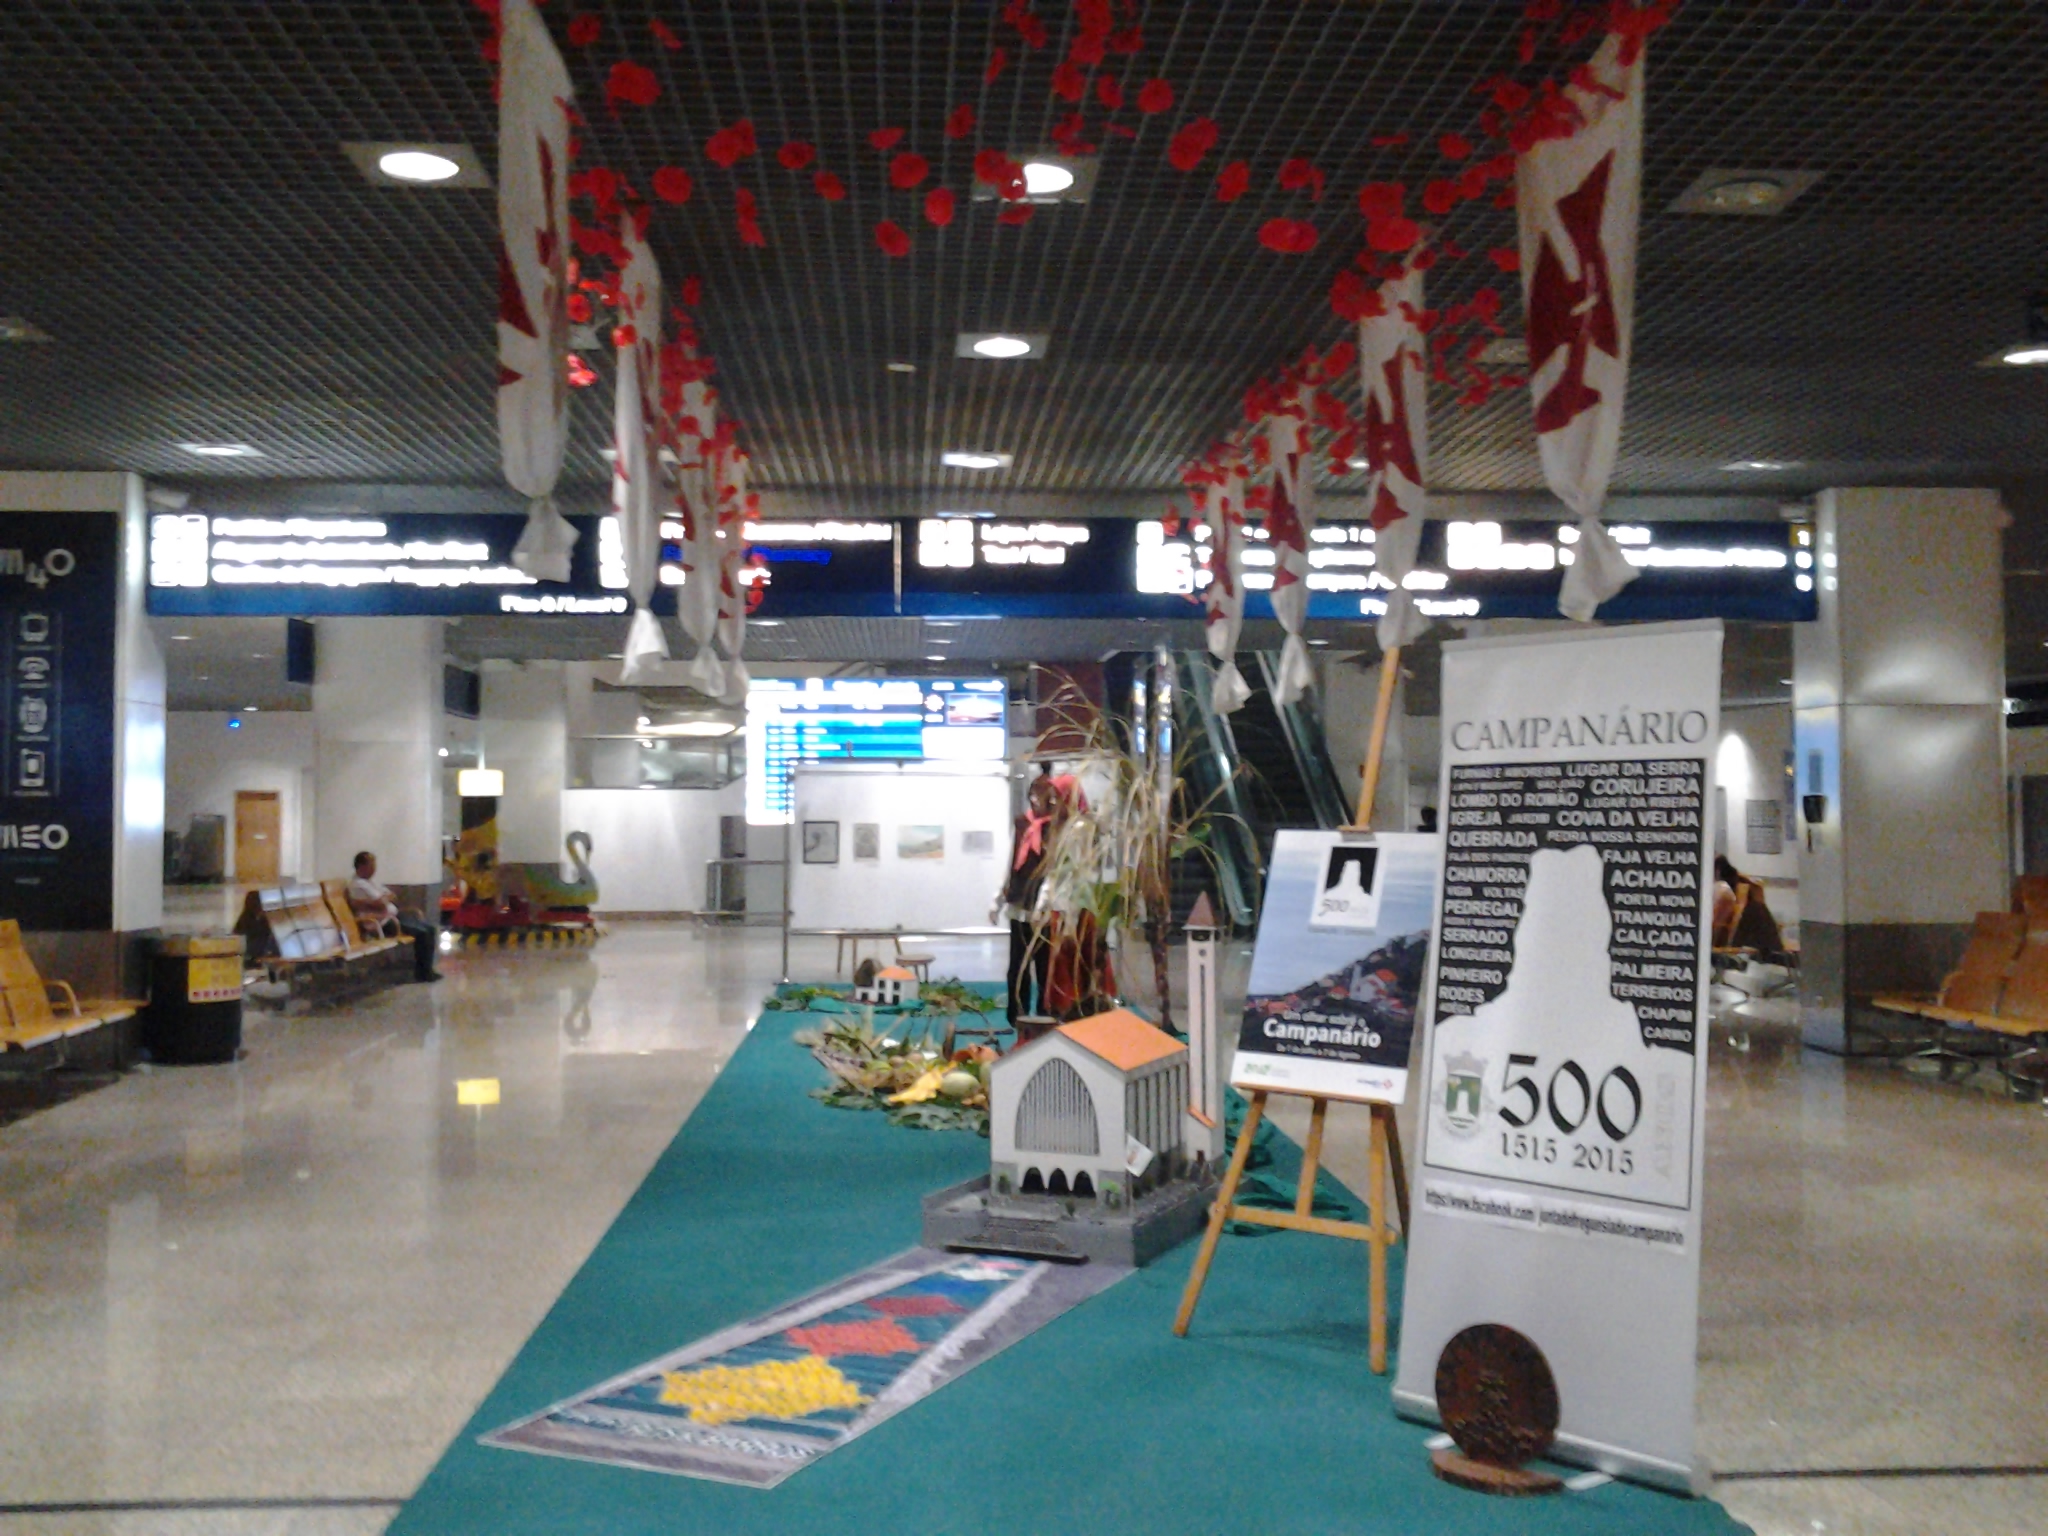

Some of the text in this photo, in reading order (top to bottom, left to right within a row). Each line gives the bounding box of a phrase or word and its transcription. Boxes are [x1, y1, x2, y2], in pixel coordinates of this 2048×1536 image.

[1450, 704, 1709, 752] CAMPANÁRIO
[1565, 762, 1619, 777] LUGAR
[1621, 762, 1645, 777] DA
[1646, 760, 1701, 776] SERRA
[1589, 777, 1700, 795] CORUJEIRA
[1451, 793, 1498, 808] LOMBO
[1500, 792, 1522, 807] DO
[1583, 797, 1627, 809] LUGAR
[1629, 797, 1648, 808] DA
[1450, 811, 1502, 826] IGREJA
[1556, 810, 1607, 827] COVA
[1608, 810, 1635, 827] DA
[1636, 810, 1699, 827] VELHA
[1449, 830, 1538, 848] QUEBRADA
[1635, 831, 1698, 844] SENHORA
[1644, 850, 1698, 866] VELHA
[1446, 866, 1527, 883] CHAMORRA
[1610, 868, 1696, 890] ACHADA
[1444, 899, 1520, 917] PEDREGAL
[1612, 909, 1697, 928] TRANQUAL
[1442, 927, 1508, 945] SERRADO
[1615, 928, 1695, 947] CALÇADA
[1441, 946, 1513, 963] LONGUEIRA
[1440, 966, 1503, 985] PINHEIRO
[1611, 961, 1694, 982] PALMEIRA
[1438, 986, 1486, 1004] RODES
[1612, 983, 1693, 1002] TERREIROS
[1262, 1016, 1383, 1049] Campanário
[1498, 1053, 1642, 1142] 500
[1501, 1132, 1634, 1177] 1515 2015
